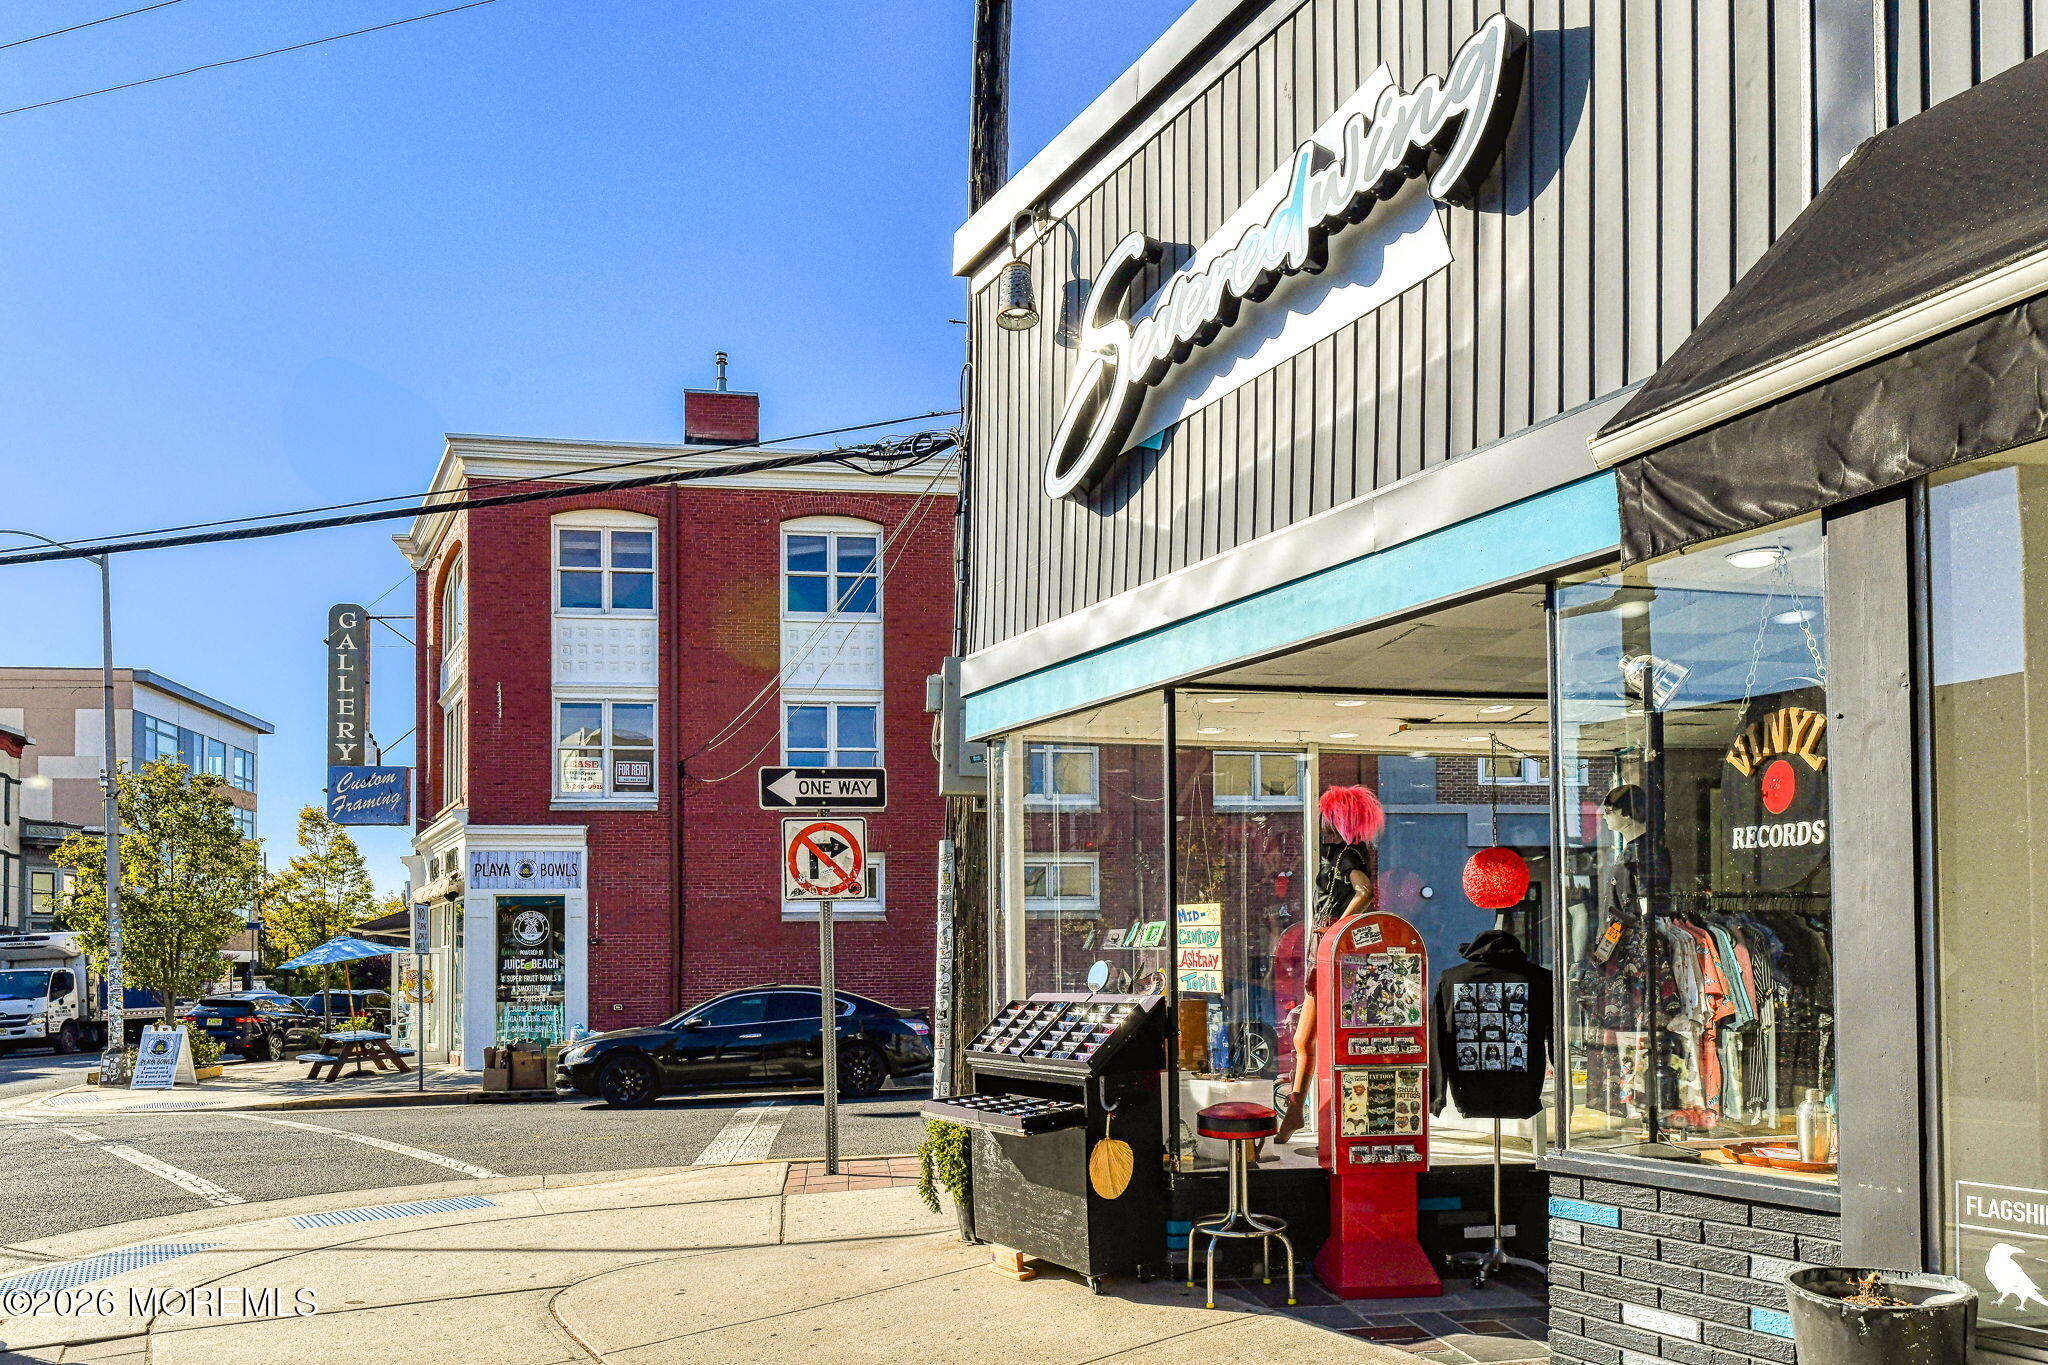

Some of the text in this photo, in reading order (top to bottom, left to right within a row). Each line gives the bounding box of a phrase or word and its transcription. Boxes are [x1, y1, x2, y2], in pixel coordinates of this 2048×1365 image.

[335, 612, 358, 761] GALLERY
[1726, 707, 1827, 777] VINYL
[618, 764, 647, 776] FOR RENT
[336, 772, 396, 793] Custom
[798, 781, 872, 795] ONE WAY
[332, 793, 401, 818] Framing
[1732, 820, 1826, 849] RECORDS
[474, 863, 578, 877] PLAYA BOWLS
[503, 959, 559, 970] JUICE BEACH
[540, 974, 557, 982] BOWLS
[1966, 1195, 2048, 1226] FLAGSHI
